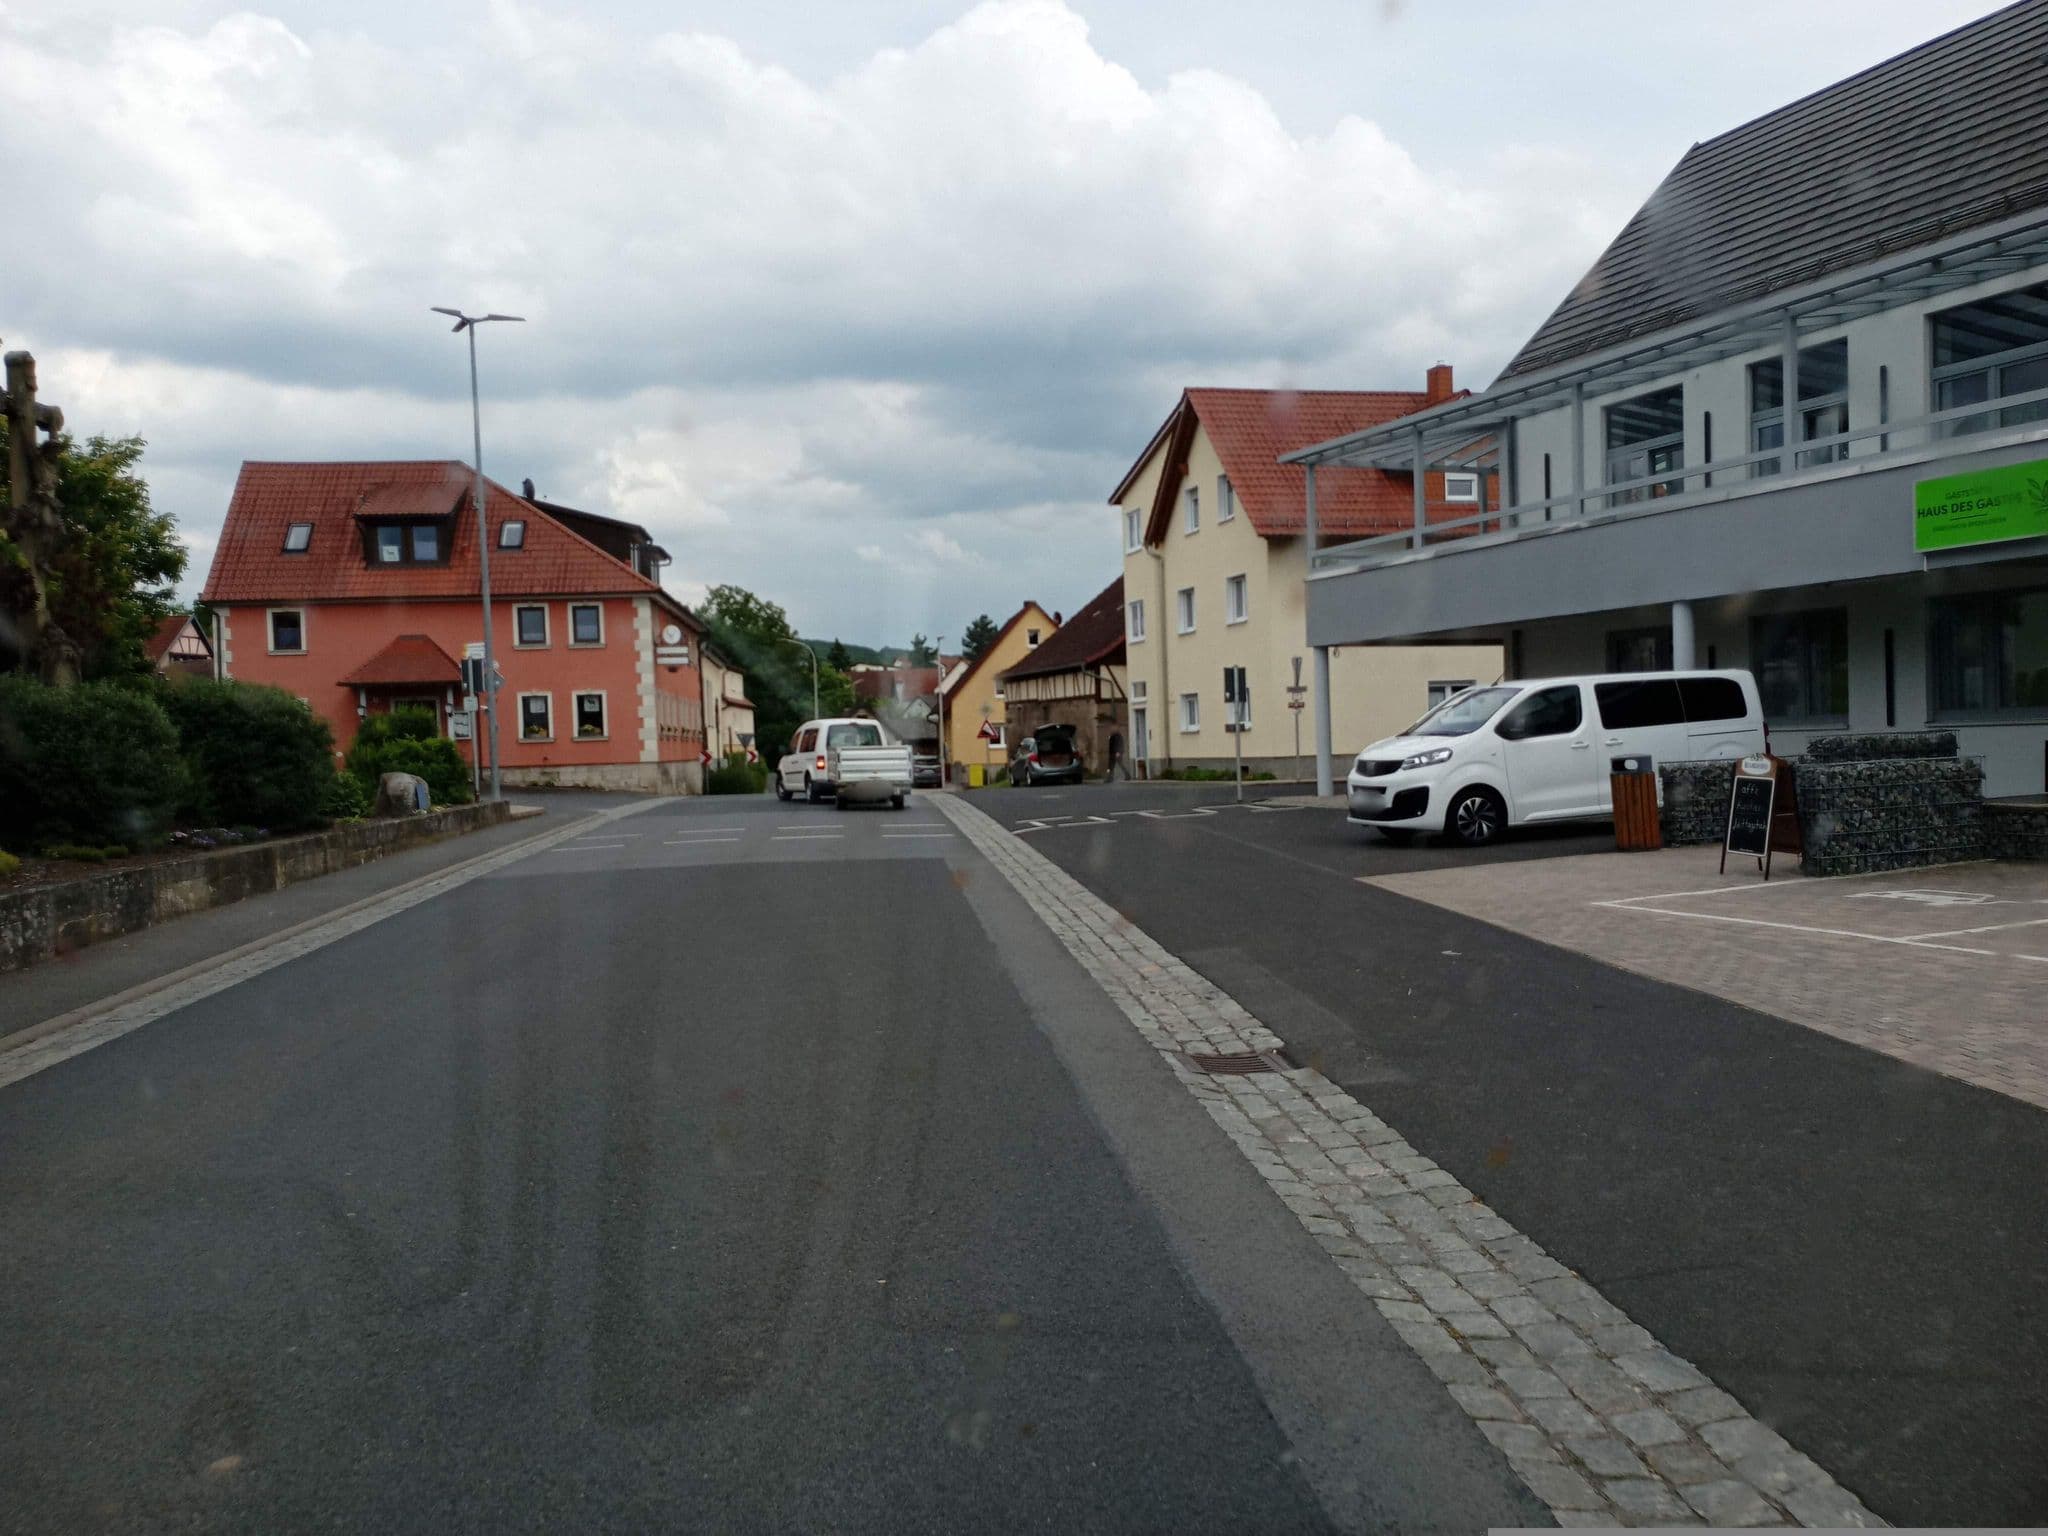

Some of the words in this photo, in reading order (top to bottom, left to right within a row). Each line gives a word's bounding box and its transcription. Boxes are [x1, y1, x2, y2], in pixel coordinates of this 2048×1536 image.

[1917, 504, 1948, 519] HAUS
[1951, 500, 1974, 514] DES
[1976, 491, 2023, 510] GAS
